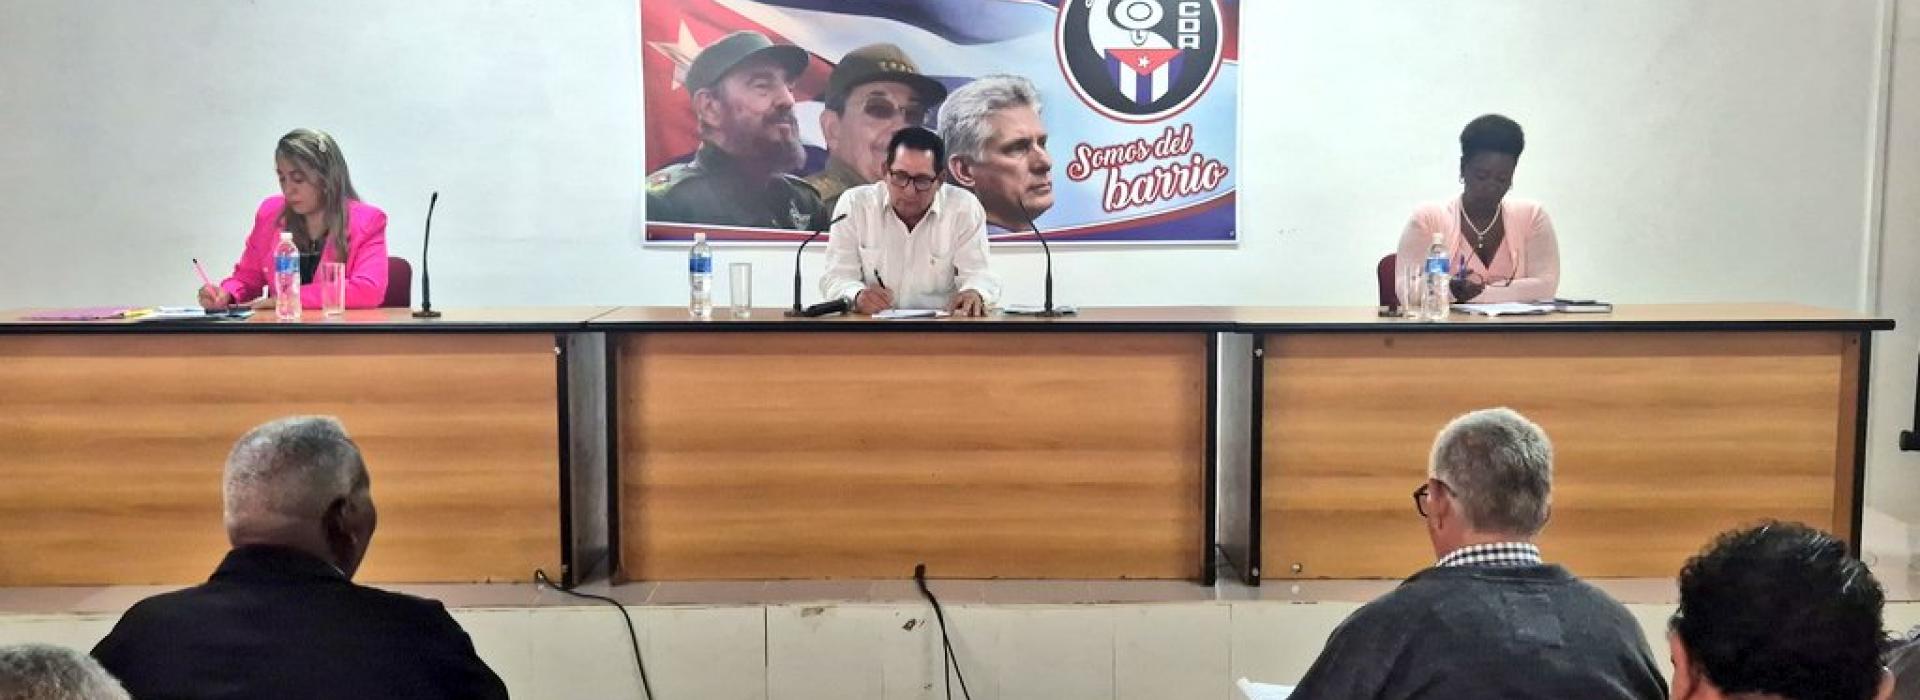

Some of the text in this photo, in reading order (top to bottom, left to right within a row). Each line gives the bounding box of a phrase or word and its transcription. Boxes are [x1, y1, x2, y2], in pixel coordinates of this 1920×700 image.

[1067, 124, 1193, 181] Somos del
[1103, 153, 1228, 212] barrio
